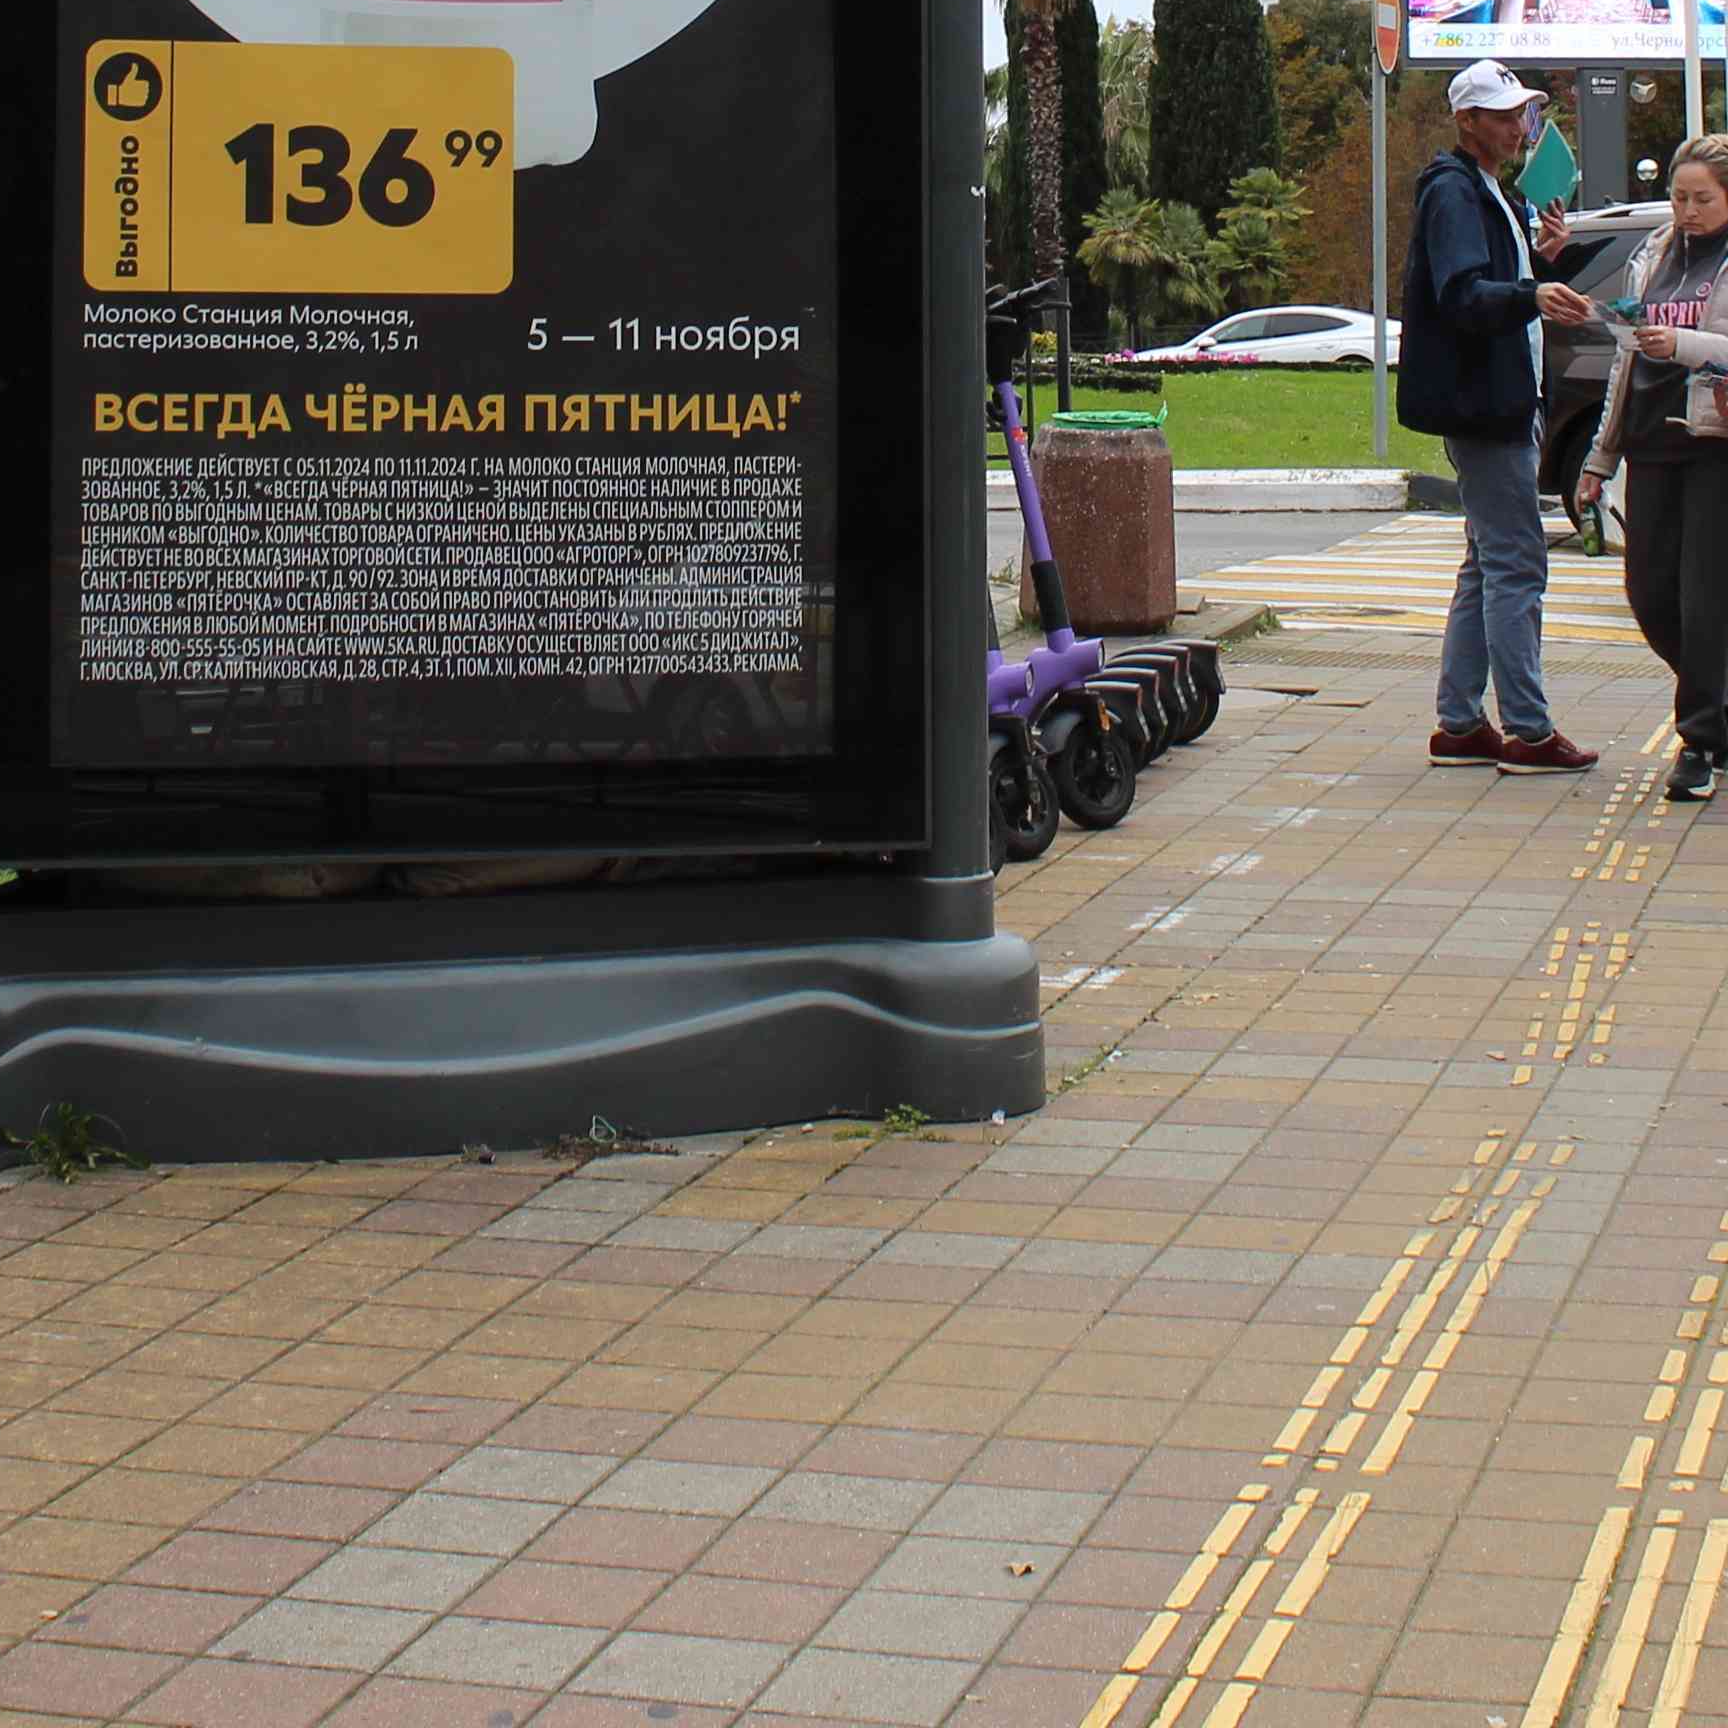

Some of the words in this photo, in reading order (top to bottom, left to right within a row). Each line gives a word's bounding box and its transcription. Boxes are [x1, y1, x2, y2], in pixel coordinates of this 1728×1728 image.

[225, 123, 435, 228] 136
[444, 130, 504, 169] 99
[115, 135, 140, 278] Выгодно
[83, 304, 177, 324] Молоко
[182, 304, 284, 327] Станция
[289, 305, 416, 328] Молочная,
[1659, 301, 1709, 328] SPRIN
[83, 330, 301, 354] пастеризованное,
[306, 330, 367, 353] 3,2%,
[370, 331, 399, 353] 1,5
[404, 337, 419, 351] л
[527, 317, 548, 351] 5
[608, 318, 642, 350] 11
[654, 316, 802, 359] ноября
[93, 392, 290, 440] ВСЕГДА
[305, 382, 505, 432] ЧЁРНАЯ
[80, 457, 193, 479] ПРЕДЛОЖЕНИЕ
[196, 454, 279, 479] ДЕЙСТВУЕТ
[296, 457, 371, 477] 05.11.2024
[398, 457, 465, 476] 11.11.2024
[508, 457, 572, 476] МОЛОКО
[575, 457, 641, 477] СТАНЦИЯ
[645, 456, 730, 477] МОЛОЧНАЯ,
[734, 456, 803, 474] ПАСТЕРИ-
[80, 480, 166, 501] ЗОВАННОЕ,
[169, 480, 210, 501] 3,2%,
[331, 477, 387, 499] ЧЁРНАЯ
[391, 480, 473, 500] ПЯТНИЦА!»
[493, 479, 547, 498] ЗНАЧИТ
[552, 479, 647, 497] ПОСТОЯННОЕ
[650, 479, 718, 497] НАЛИЧИЕ
[734, 478, 803, 498] ПРОДАЖЕ
[81, 503, 149, 522] ТОВАРОВ
[175, 503, 263, 523] ВЫГОДНЫМ
[266, 502, 323, 523] ЦЕНАМ.
[324, 502, 380, 521] ТОВАРЫ
[396, 499, 454, 521] НИЗКОЙ
[456, 499, 506, 522] ЦЕНОЙ
[509, 501, 590, 522] ВЫДЕЛЕНЫ
[592, 501, 703, 521] СПЕЦИАЛЬНЫМ
[705, 500, 790, 518] СТОППЕРОМ
[80, 526, 165, 546] ЦЕННИКОМ
[168, 525, 265, 546] «ВЫГОДНО».
[265, 525, 359, 544] КОЛИЧЕСТВО
[361, 525, 415, 543] ТОВАРА
[416, 524, 515, 543] ОГРАНИЧЕНО.
[515, 524, 559, 544] ЦЕНЫ
[559, 523, 625, 542] УКАЗАНЫ
[639, 522, 697, 541] РУБЛЯХ.
[699, 522, 803, 542] ПРЕДЛОЖЕНИЕ
[80, 545, 163, 569] ДЕЙСТВУЕТ
[206, 548, 242, 567] ВСЕХ
[242, 547, 330, 566] МАГАЗИНАХ
[331, 544, 404, 566] ТОРГОВОЙ
[406, 546, 445, 565] СЕТИ.
[445, 546, 523, 567] ПРОДАВЕЦ
[556, 545, 647, 566] «АГРОТОРГ»,
[647, 544, 684, 563] ОГРН
[80, 570, 214, 592] САНКТ-ПЕТЕРБУРГ,
[216, 567, 284, 589] НЕВСКИЙ
[285, 570, 330, 590] ПР-КТ,
[400, 569, 437, 588] ЗОНА
[454, 568, 502, 587] ВРЕМЯ
[503, 568, 578, 589] ДОСТАВКИ
[579, 567, 678, 586] ОГРАНИЧЕНЫ.
[678, 566, 803, 587] АДМИНИСТРАЦИЯ
[80, 593, 173, 612] МАГАЗИНОВ
[176, 590, 283, 611] «ПЯТЁРОЧКА»
[285, 592, 368, 611] ОСТАВЛЯЕТ
[391, 588, 441, 610] СОБОЙ
[443, 591, 491, 609] ПРАВО
[493, 590, 617, 609] ПРИОСТАНОВИТЬ
[652, 588, 729, 610] ПРОДЛИТЬ
[730, 583, 803, 609] ДЕЙСТВИЕ
[80, 616, 193, 637] ПРЕДЛОЖЕНИЯ
[204, 612, 260, 634] ЛЮБОЙ
[261, 615, 329, 634] МОМЕНТ.
[329, 614, 436, 635] ПОДРОБНОСТИ
[450, 613, 536, 631] МАГАЗИНАХ
[538, 609, 643, 632] «ПЯТЁРОЧКА»,
[667, 610, 738, 629] ТЕЛЕФОНУ
[741, 606, 803, 628] ГОРЯЧЕЙ
[80, 639, 133, 658] ЛИНИИ
[135, 638, 261, 657] 8-800-555-55-05
[296, 634, 342, 656] САЙТЕ
[441, 635, 515, 656] ДОСТАВКУ
[516, 634, 626, 655] ОСУЩЕСТВЛЯЕТ
[662, 633, 702, 651] «ИКС
[710, 632, 803, 652] ДИДЖИТАЛ»,
[91, 661, 157, 682] МОСКВА,
[204, 660, 342, 681] КАЛИТНИКОВСКАЯ,
[588, 656, 625, 675] ОГРН
[733, 653, 803, 672] РЕКЛАМА.
